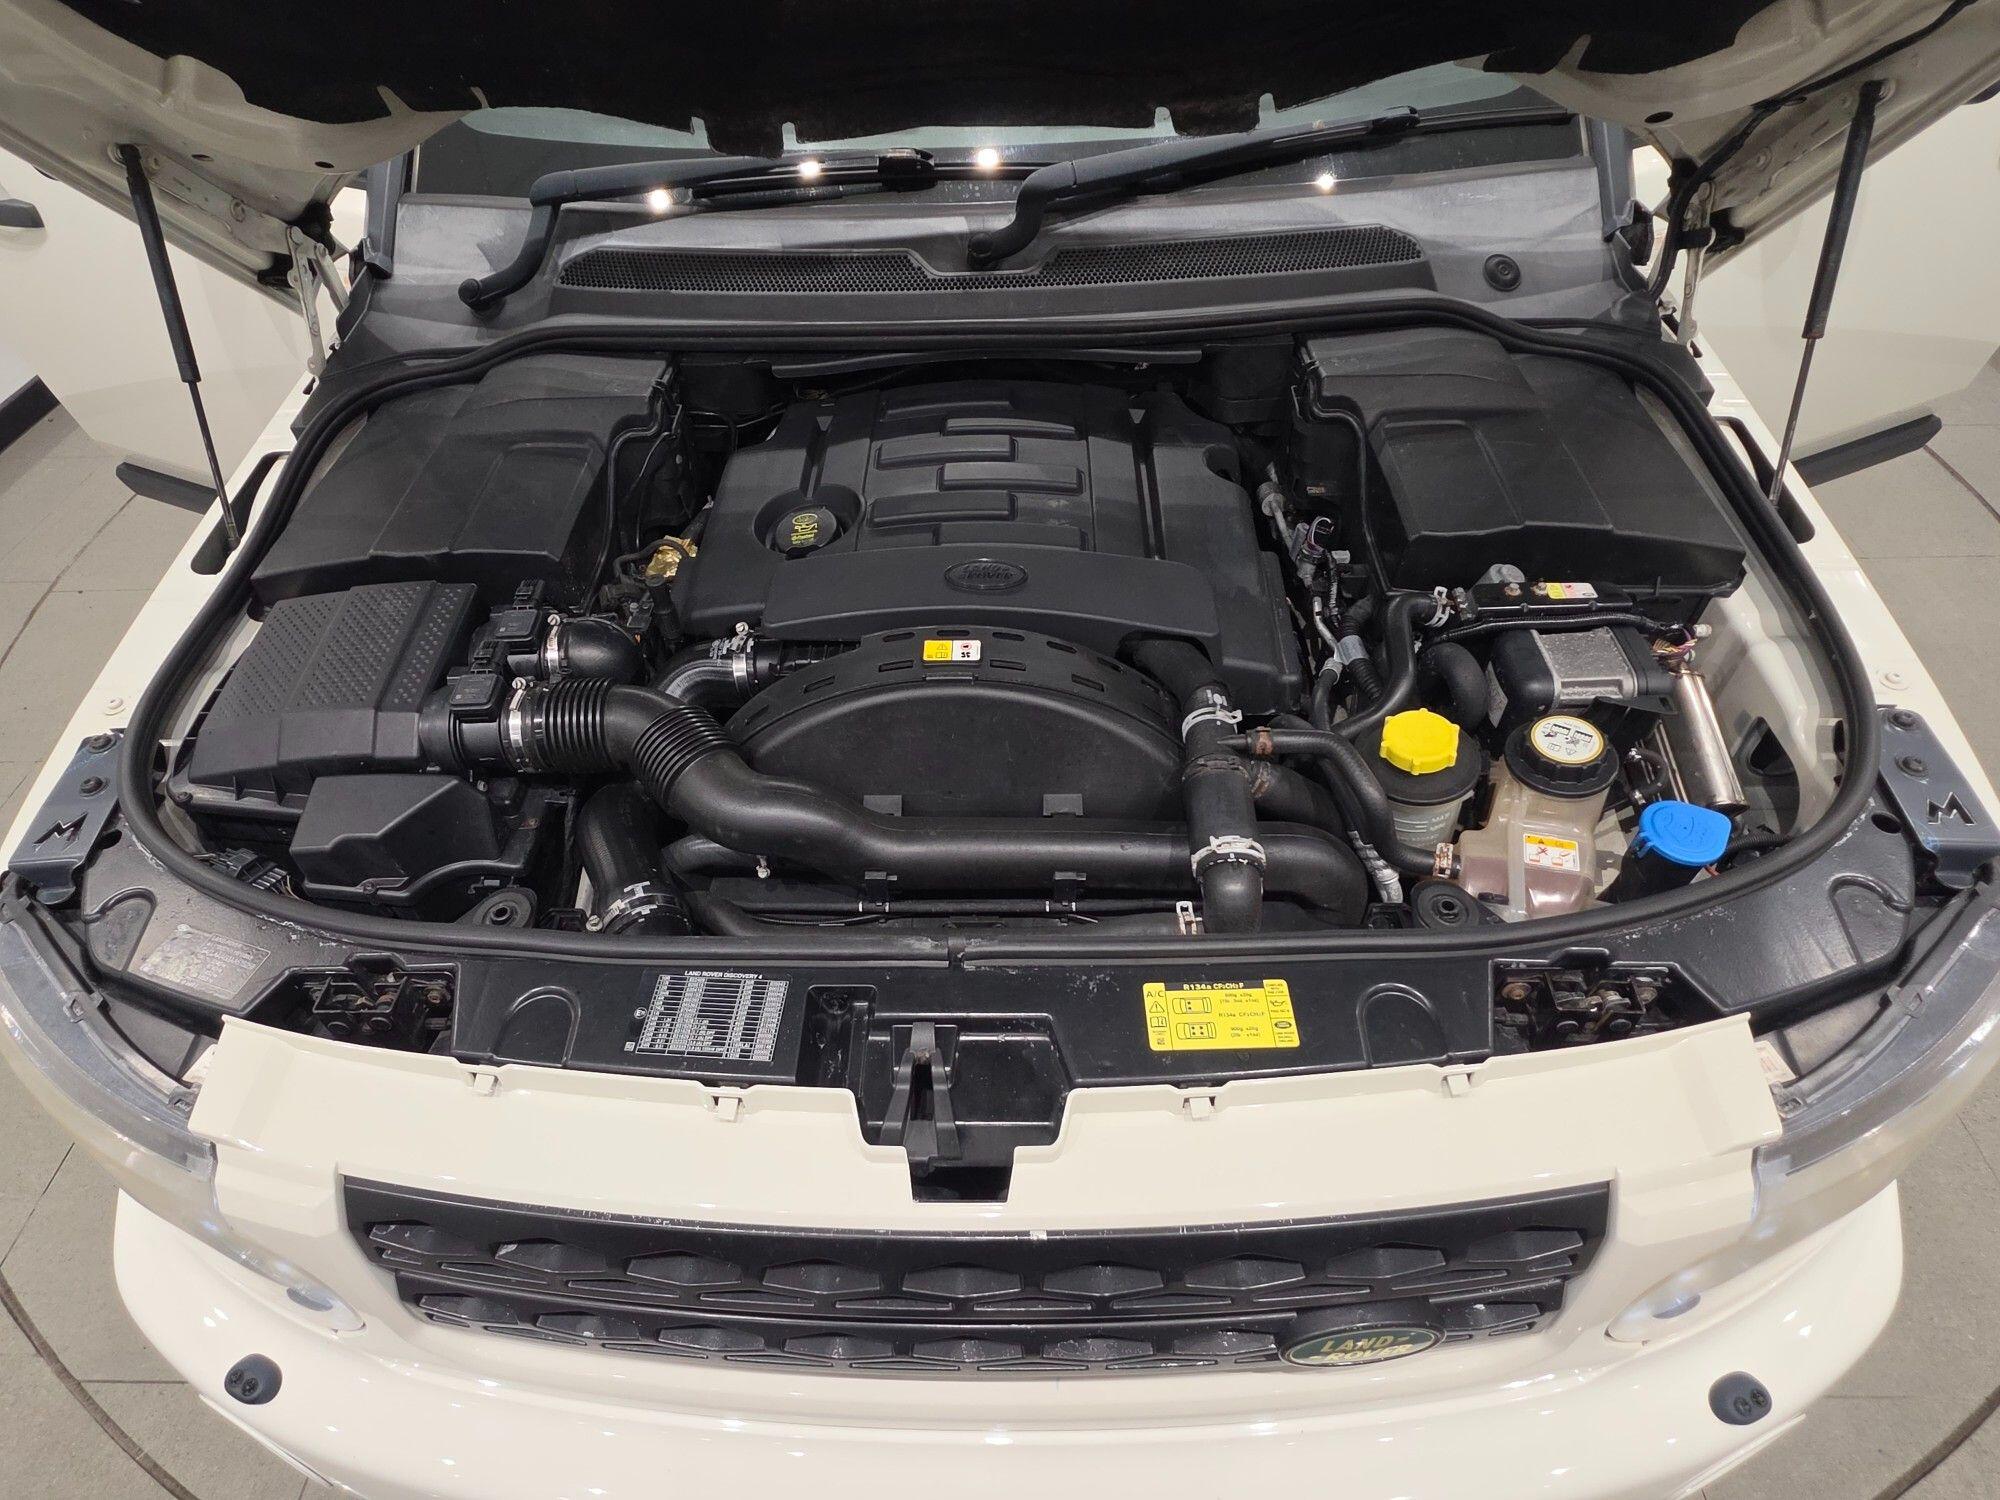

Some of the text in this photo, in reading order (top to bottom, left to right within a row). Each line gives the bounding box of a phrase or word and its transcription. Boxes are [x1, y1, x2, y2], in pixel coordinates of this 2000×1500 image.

[1183, 983, 1212, 991] R134a
[1146, 990, 1165, 998] A/C
[1320, 1335, 1394, 1352] LAND
[1325, 1344, 1414, 1361] ROVER
